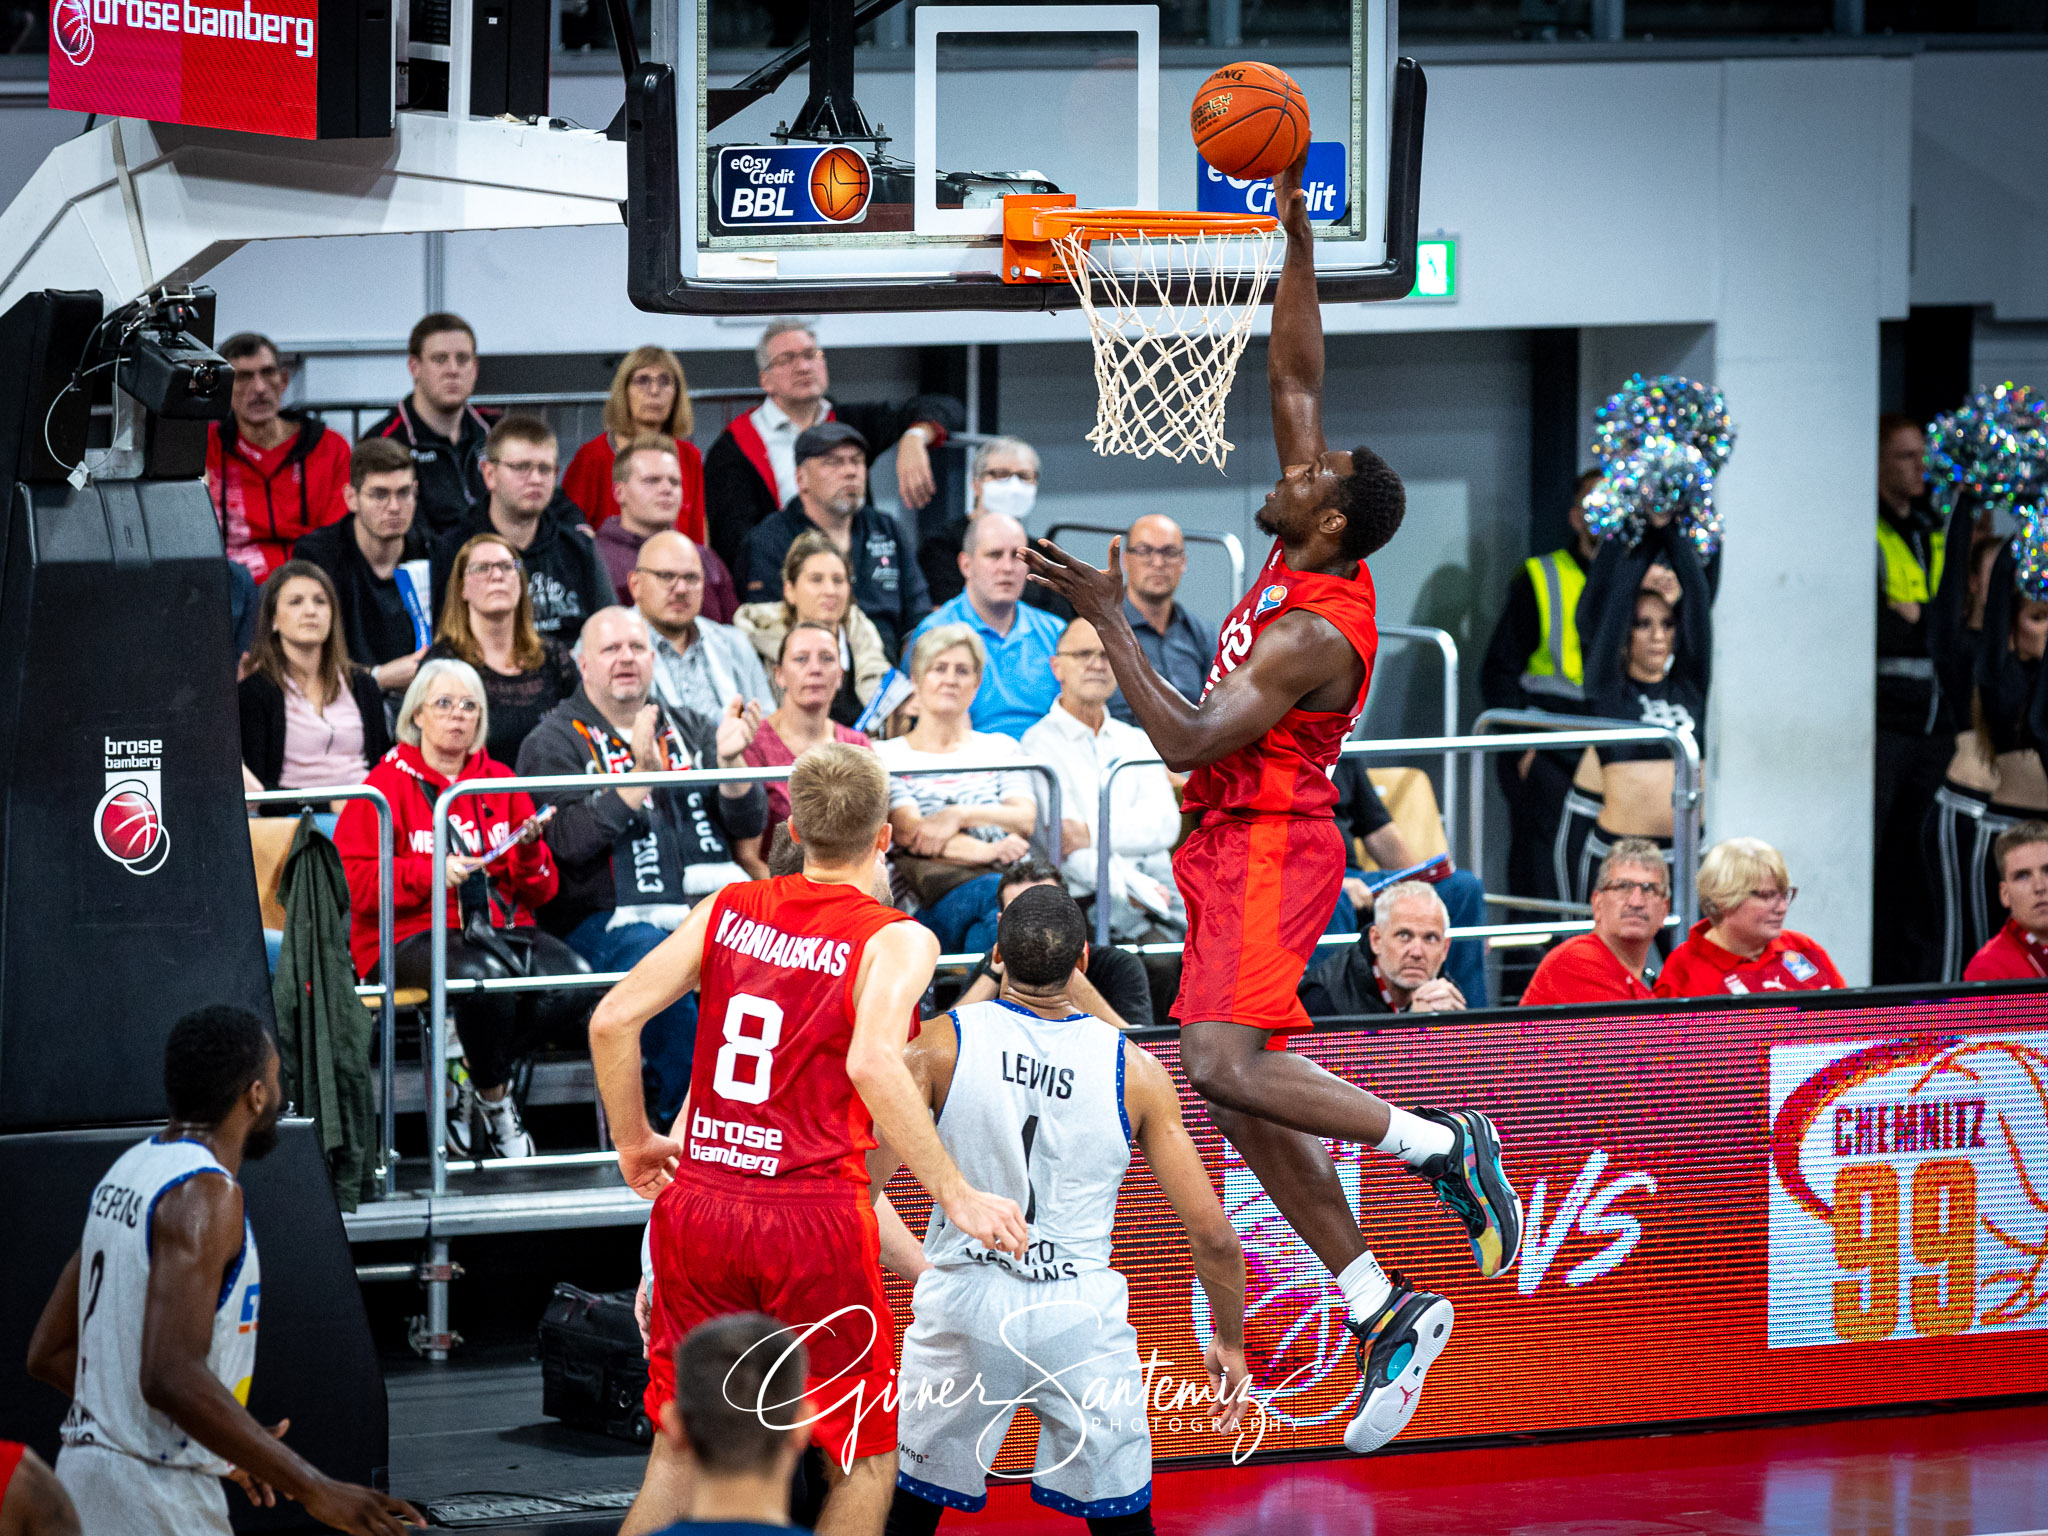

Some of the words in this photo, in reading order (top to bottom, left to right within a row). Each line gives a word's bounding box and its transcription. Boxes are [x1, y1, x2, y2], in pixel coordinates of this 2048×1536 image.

[183, 0, 314, 58] bamberg
[749, 169, 795, 184] Credit
[1246, 181, 1337, 213] Crdit
[730, 187, 794, 218] BBL
[105, 736, 162, 755] brose
[105, 755, 161, 770] bamberg
[714, 909, 851, 977] KARNIAUSKAS
[713, 993, 784, 1105] 8
[691, 1107, 783, 1151] brose
[1834, 1099, 1987, 1157] CHEMNITZ
[690, 1138, 780, 1177] bamberg
[1021, 1114, 1040, 1225] 1
[1832, 1158, 1979, 1343] 99
